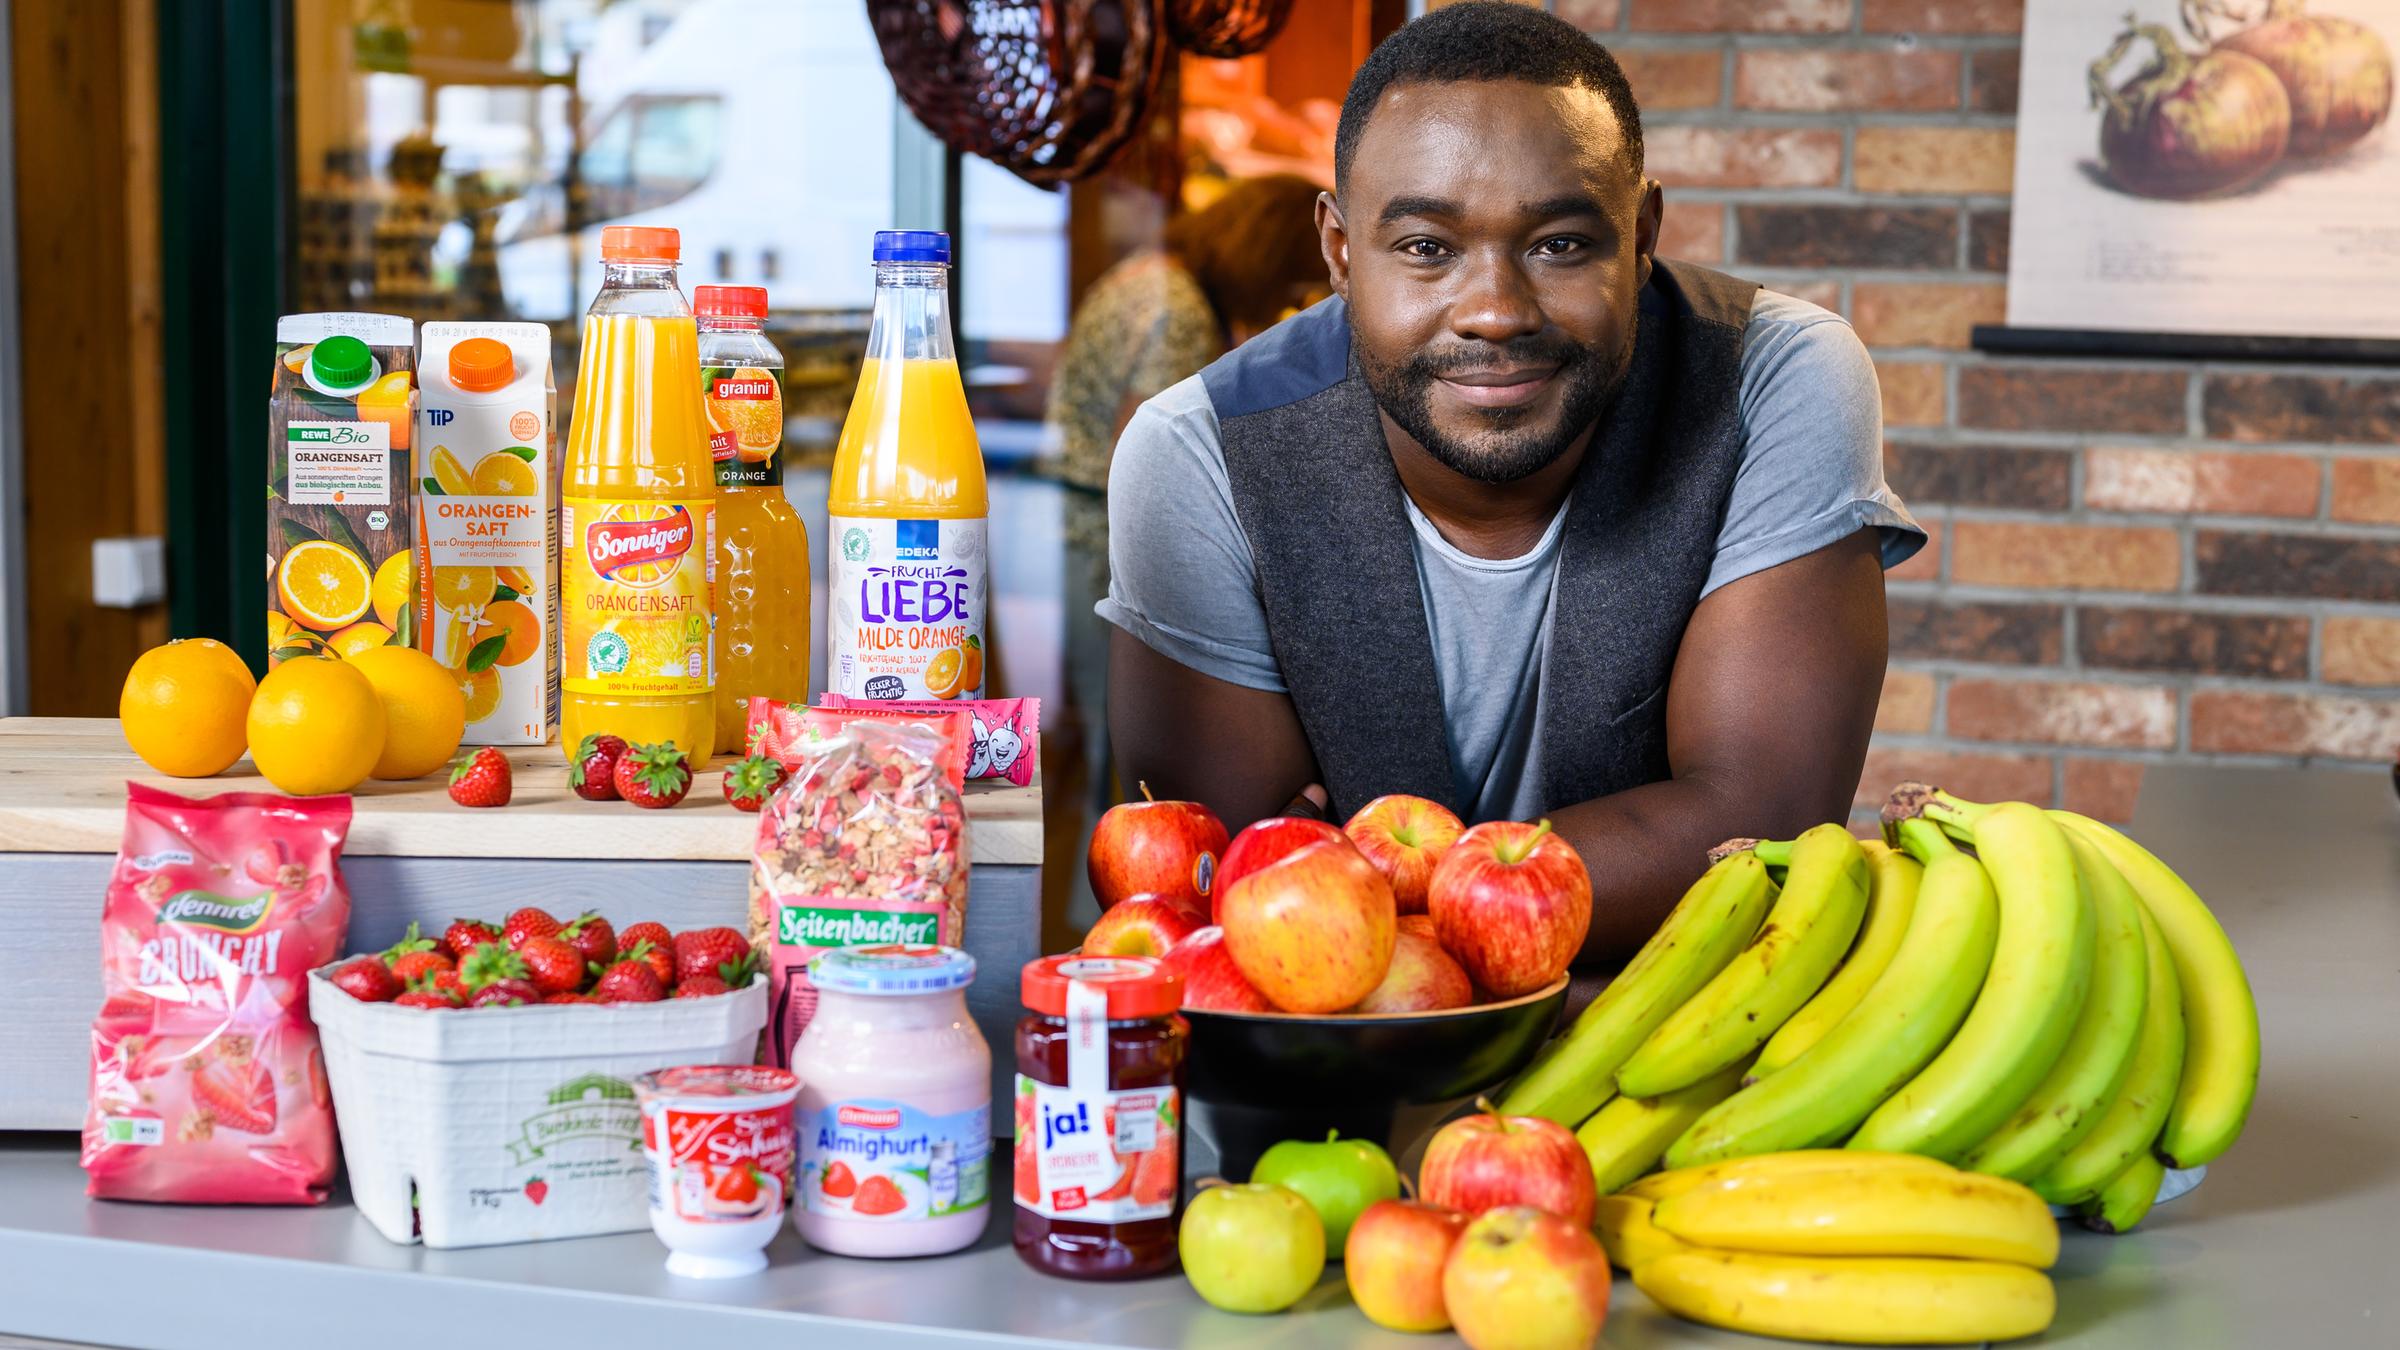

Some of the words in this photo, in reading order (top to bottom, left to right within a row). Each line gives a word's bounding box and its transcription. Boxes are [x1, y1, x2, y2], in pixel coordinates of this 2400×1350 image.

[719, 382, 769, 398] granini
[301, 431, 329, 439] REWE
[331, 427, 370, 444] Bio
[295, 452, 384, 463] ORANGENSAFT
[357, 474, 383, 482] Orangen
[722, 471, 766, 481] ORANGE
[309, 481, 356, 490] biologischem
[358, 481, 384, 489] Anbau.
[438, 503, 537, 518] ORANGEN-
[466, 521, 508, 536] SAFT
[450, 537, 541, 550] Orangensaftkonzentrat
[593, 525, 688, 561] Sonniger
[896, 547, 938, 557] EDEKA
[891, 565, 942, 579] FRUCHT
[586, 594, 695, 612] ORANGENSAFT
[861, 578, 969, 624] LIEBE
[858, 627, 905, 650] MILDE
[908, 625, 967, 650] ORANGE
[632, 683, 679, 692] Fruchtgehalt
[866, 680, 891, 691] LECKER
[892, 677, 899, 686] &
[867, 687, 903, 701] FRUCHTIG
[780, 909, 936, 946] Seitenbacher
[139, 929, 283, 986] CRUNCHY
[1044, 1102, 1090, 1150] ja!
[817, 1127, 928, 1161] Almighurt
